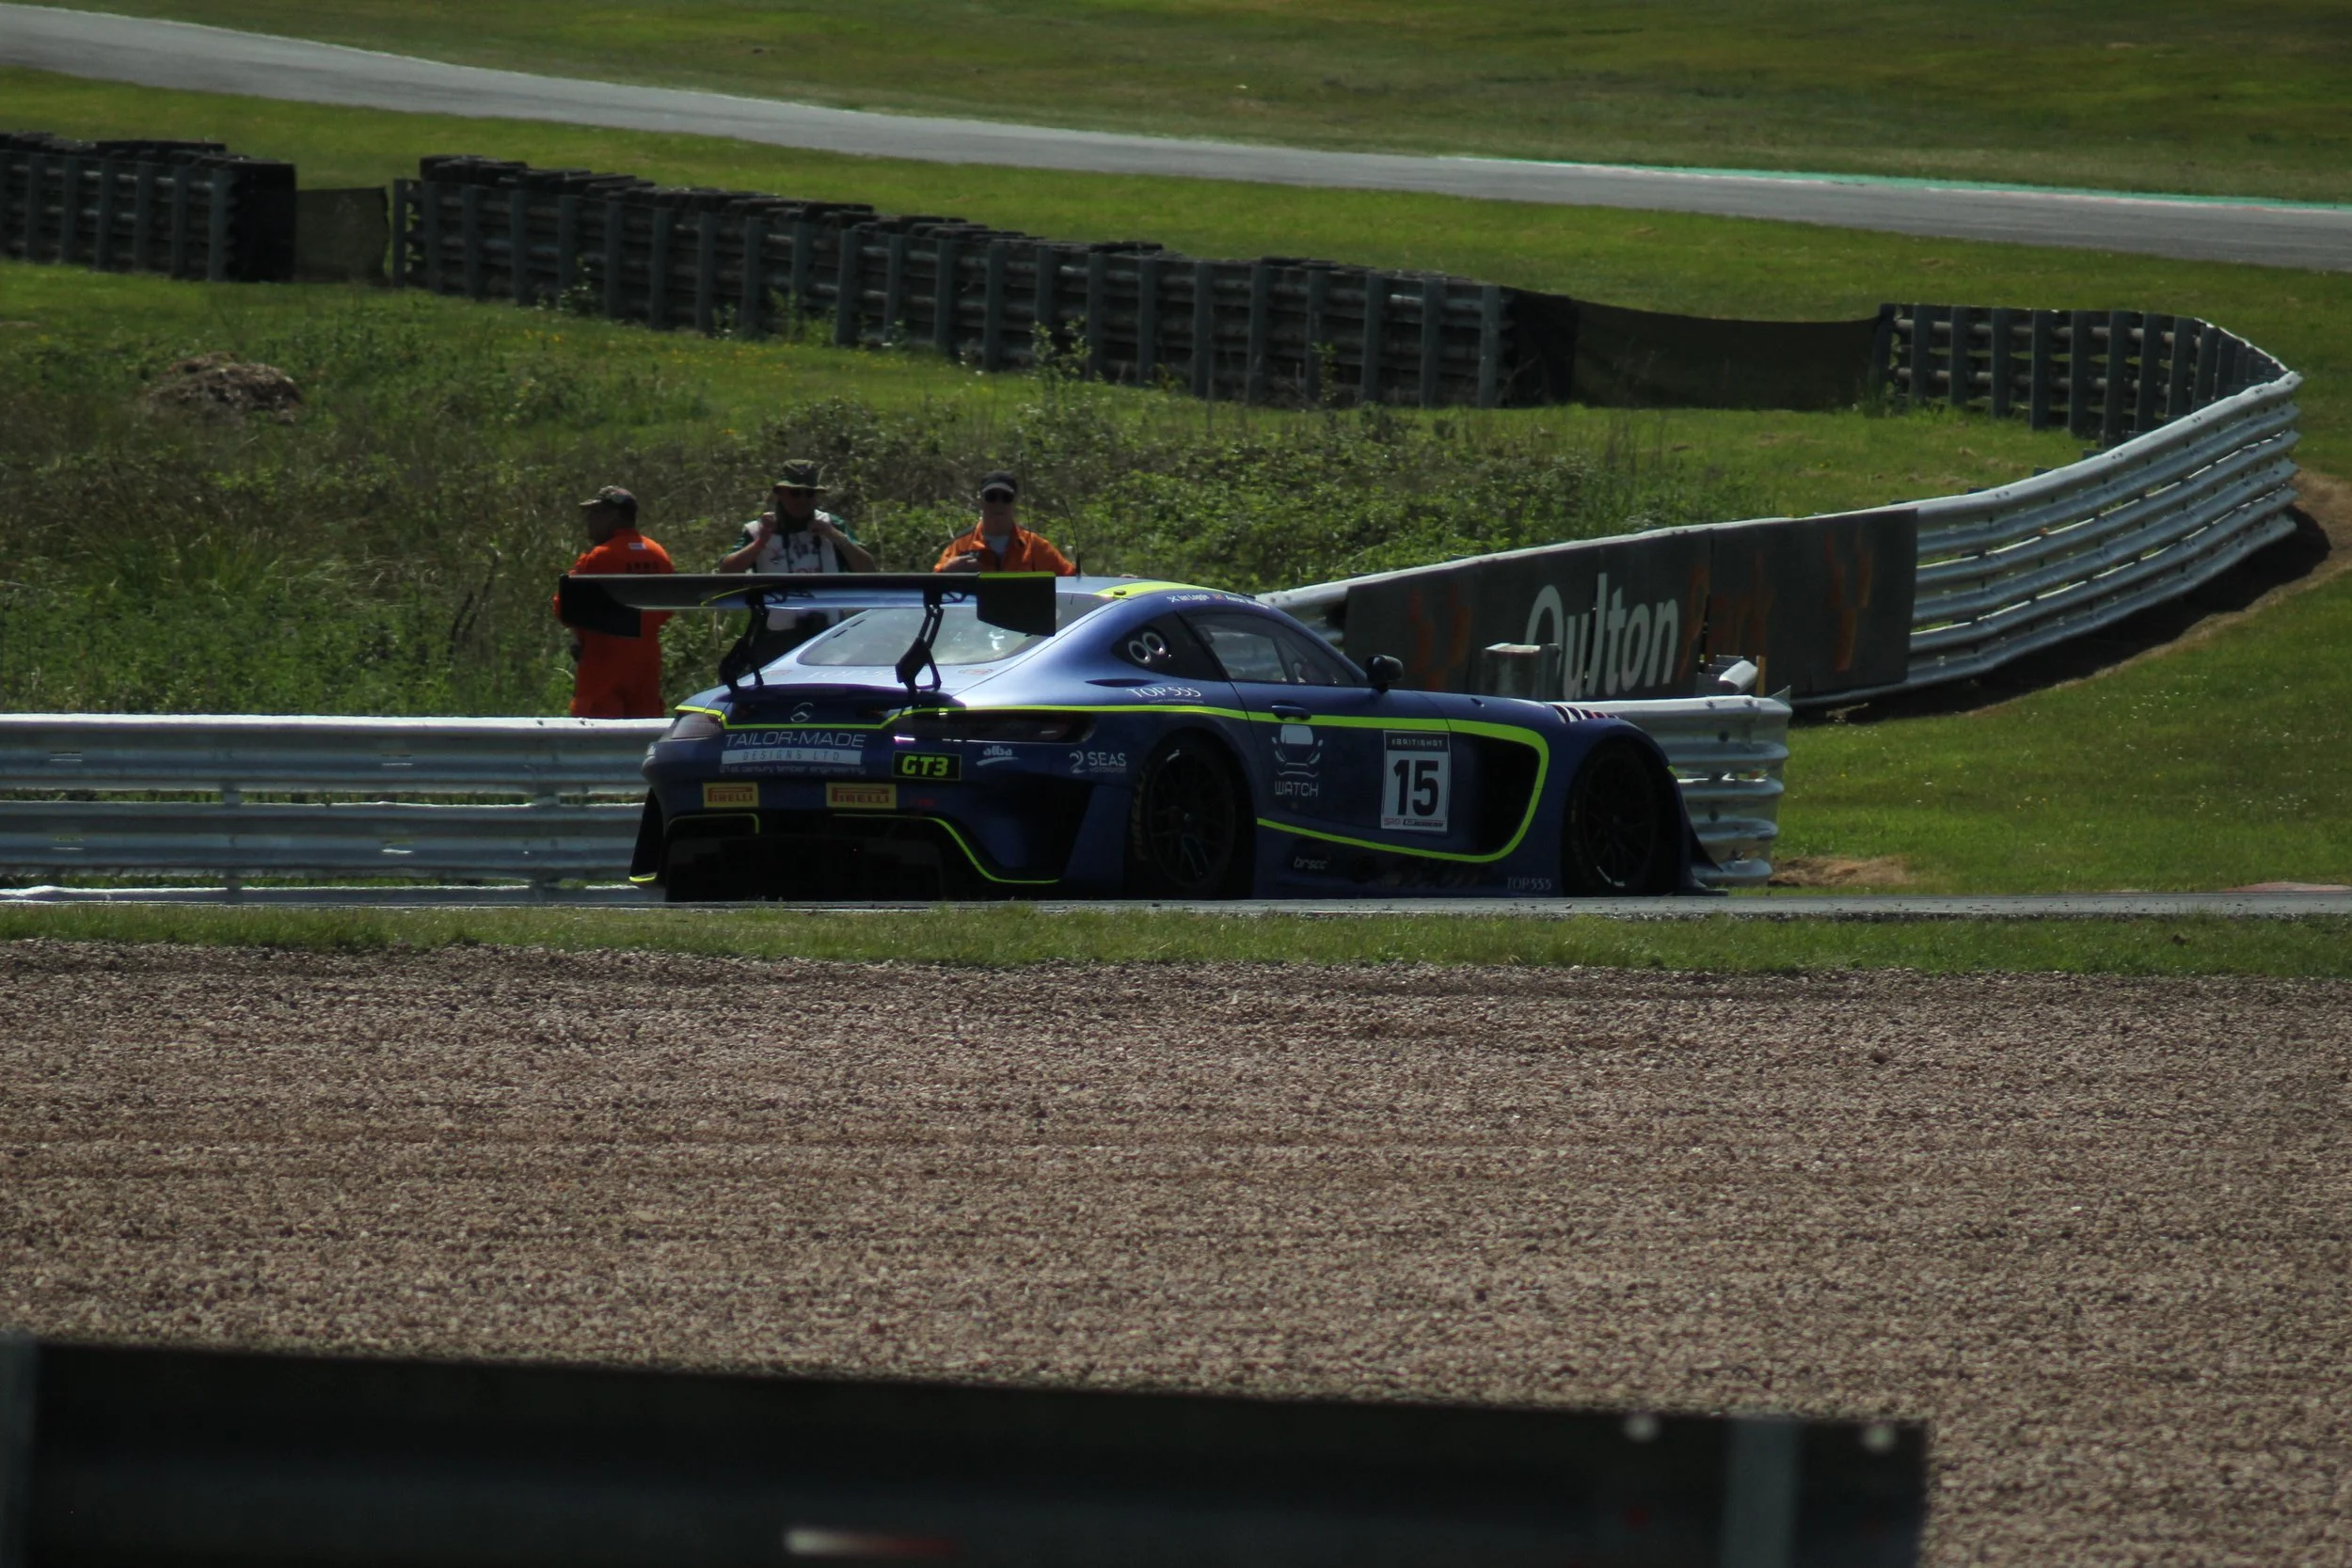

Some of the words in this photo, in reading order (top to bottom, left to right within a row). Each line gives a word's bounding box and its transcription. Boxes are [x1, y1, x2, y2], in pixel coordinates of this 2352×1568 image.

[725, 731, 867, 748] TAILOR-MADE
[742, 750, 802, 760] DESIGNS
[1069, 750, 1087, 774] 2
[1088, 752, 1127, 768] SEAS
[901, 754, 949, 777] GT3
[707, 786, 755, 802] PIRELLI
[831, 786, 890, 803] PIRELLI
[1274, 780, 1319, 798] WATCH
[1393, 759, 1439, 816] 15
